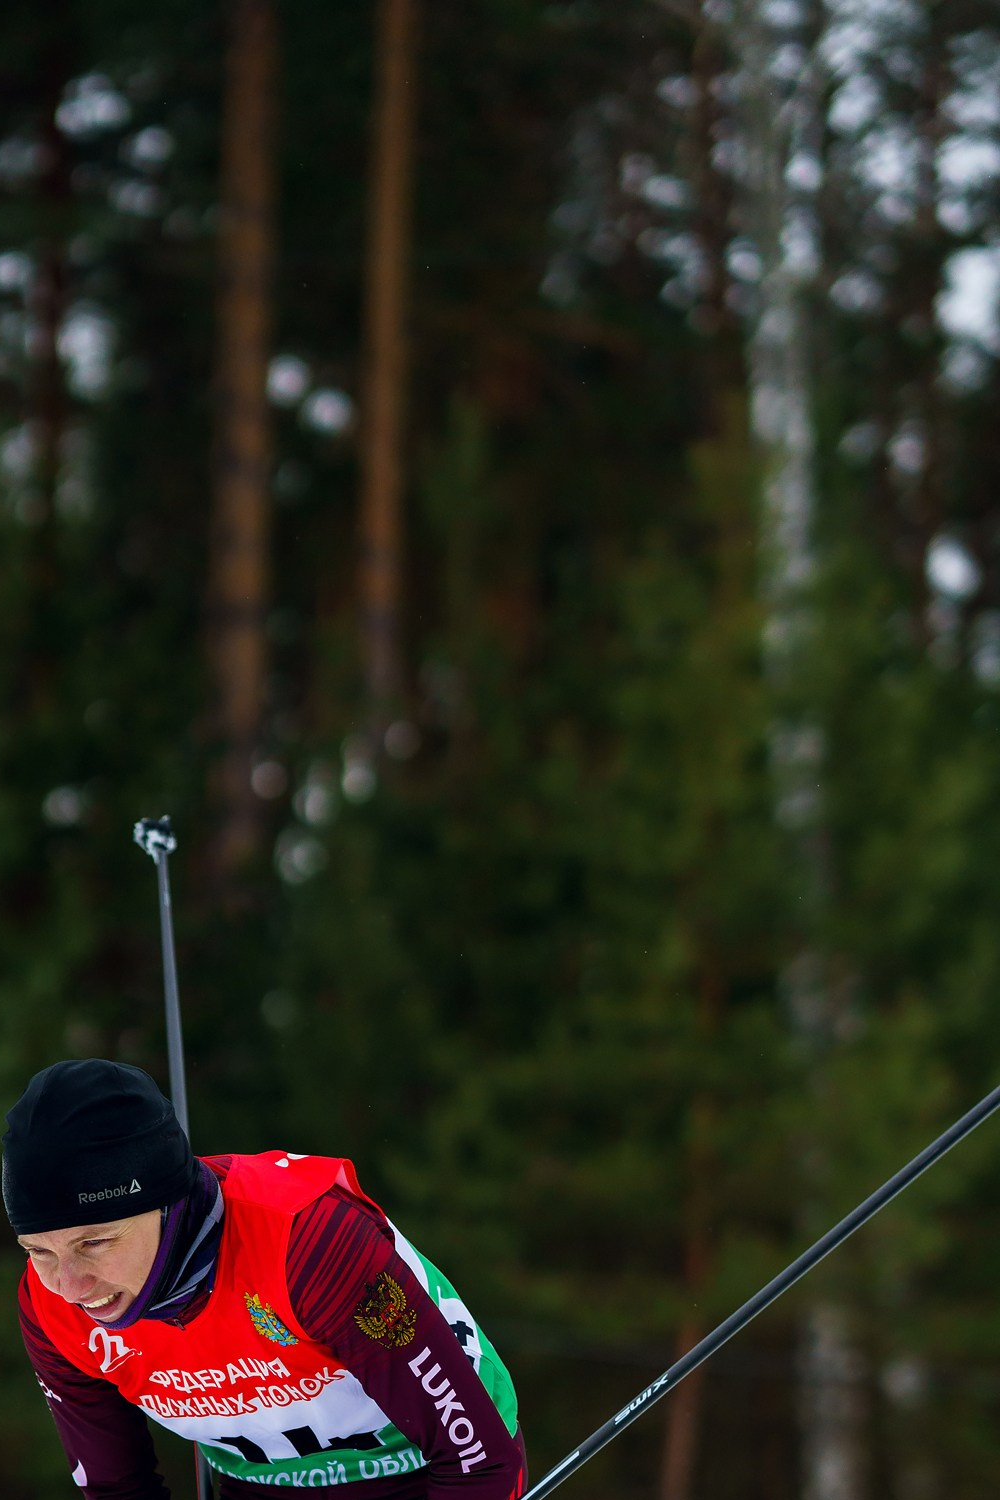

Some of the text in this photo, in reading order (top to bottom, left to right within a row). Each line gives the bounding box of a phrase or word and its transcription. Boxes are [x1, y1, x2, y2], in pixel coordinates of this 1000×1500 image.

[78, 1185, 128, 1204] Reebok
[148, 1356, 292, 1394] ФЕДЕРАЦИЯ
[407, 1346, 487, 1474] LUKOIL
[614, 1373, 669, 1425] SWIX
